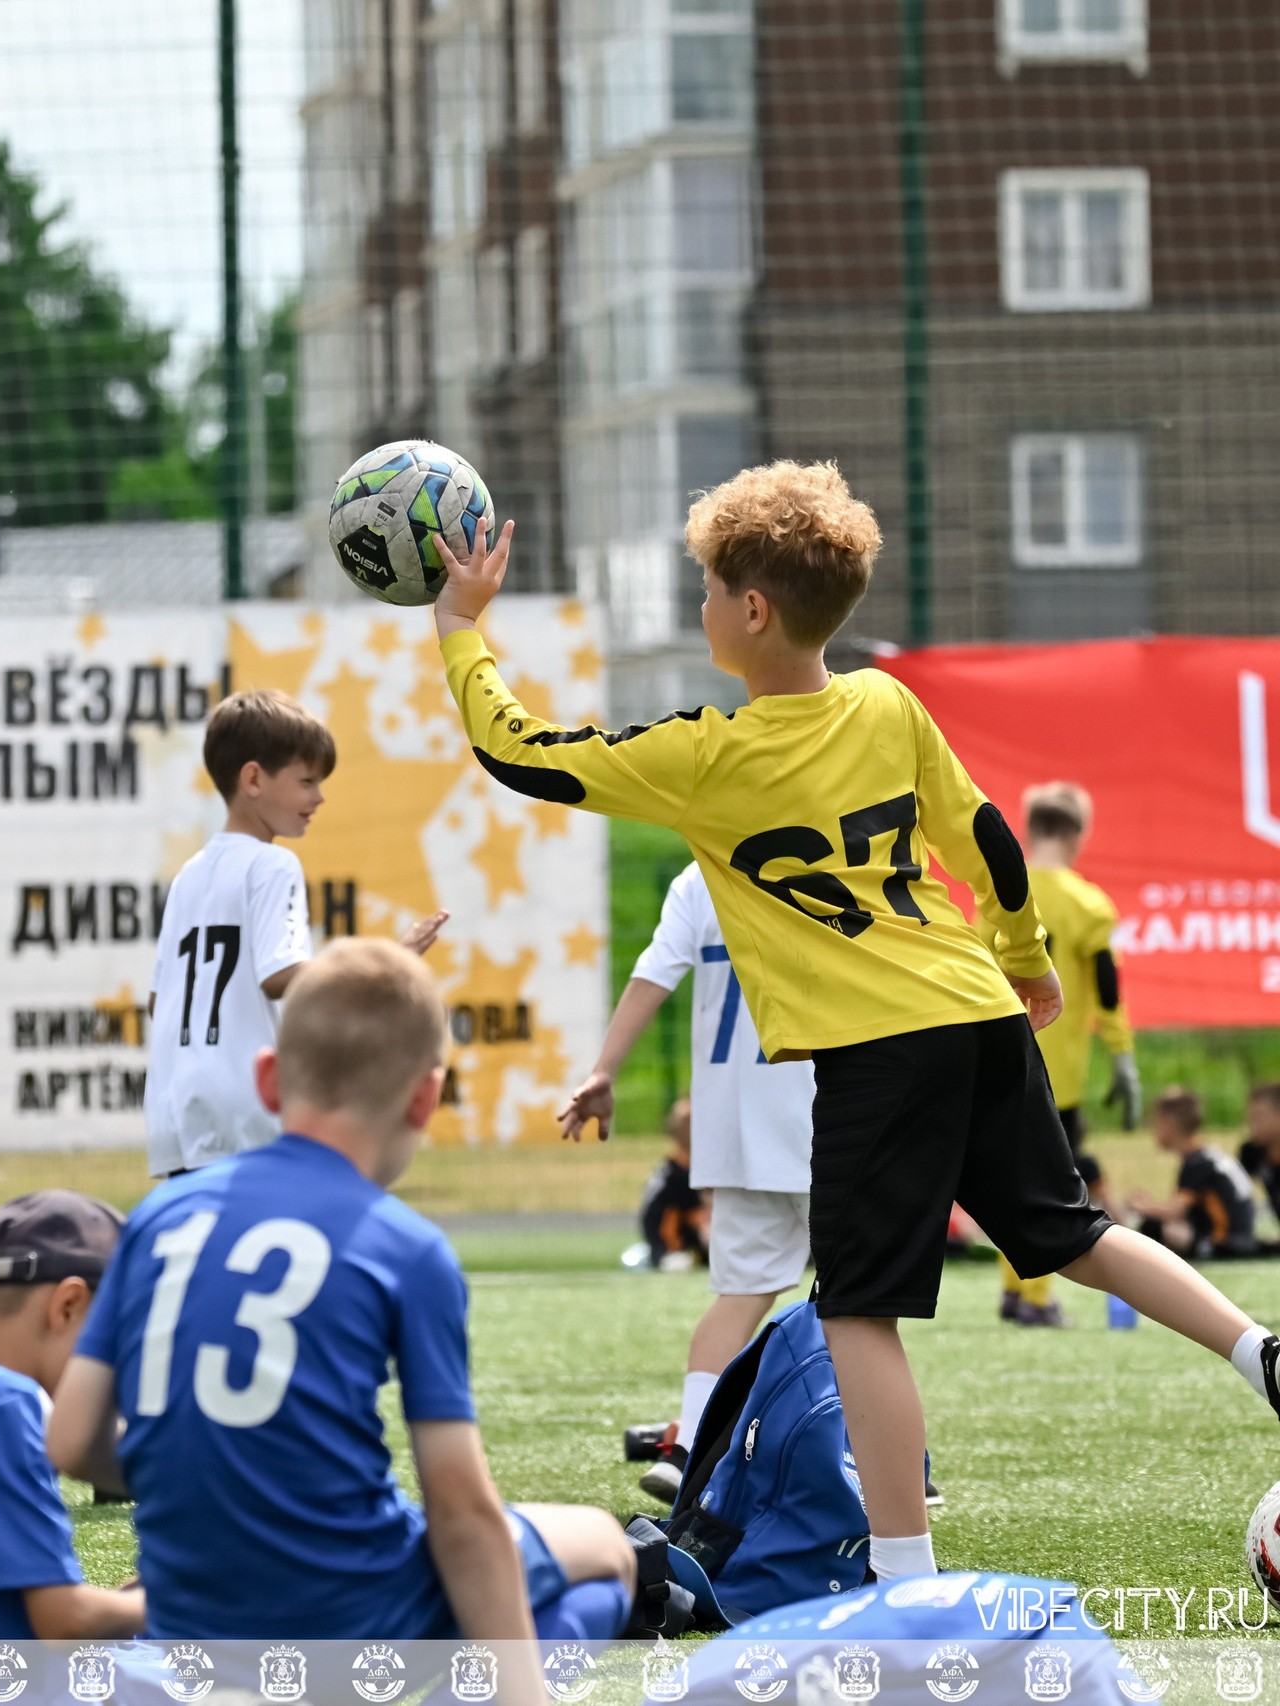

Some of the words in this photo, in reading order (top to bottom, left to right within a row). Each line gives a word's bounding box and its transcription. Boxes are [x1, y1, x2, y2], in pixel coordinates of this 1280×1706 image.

[343, 543, 389, 577] VISION
[729, 791, 931, 939] 67
[1139, 878, 1280, 908] ФУТБОЛ
[1109, 912, 1280, 953] КАЛИН
[178, 924, 240, 1047] 17
[13, 1004, 145, 1049] НИКИТ
[136, 1210, 332, 1428] 13
